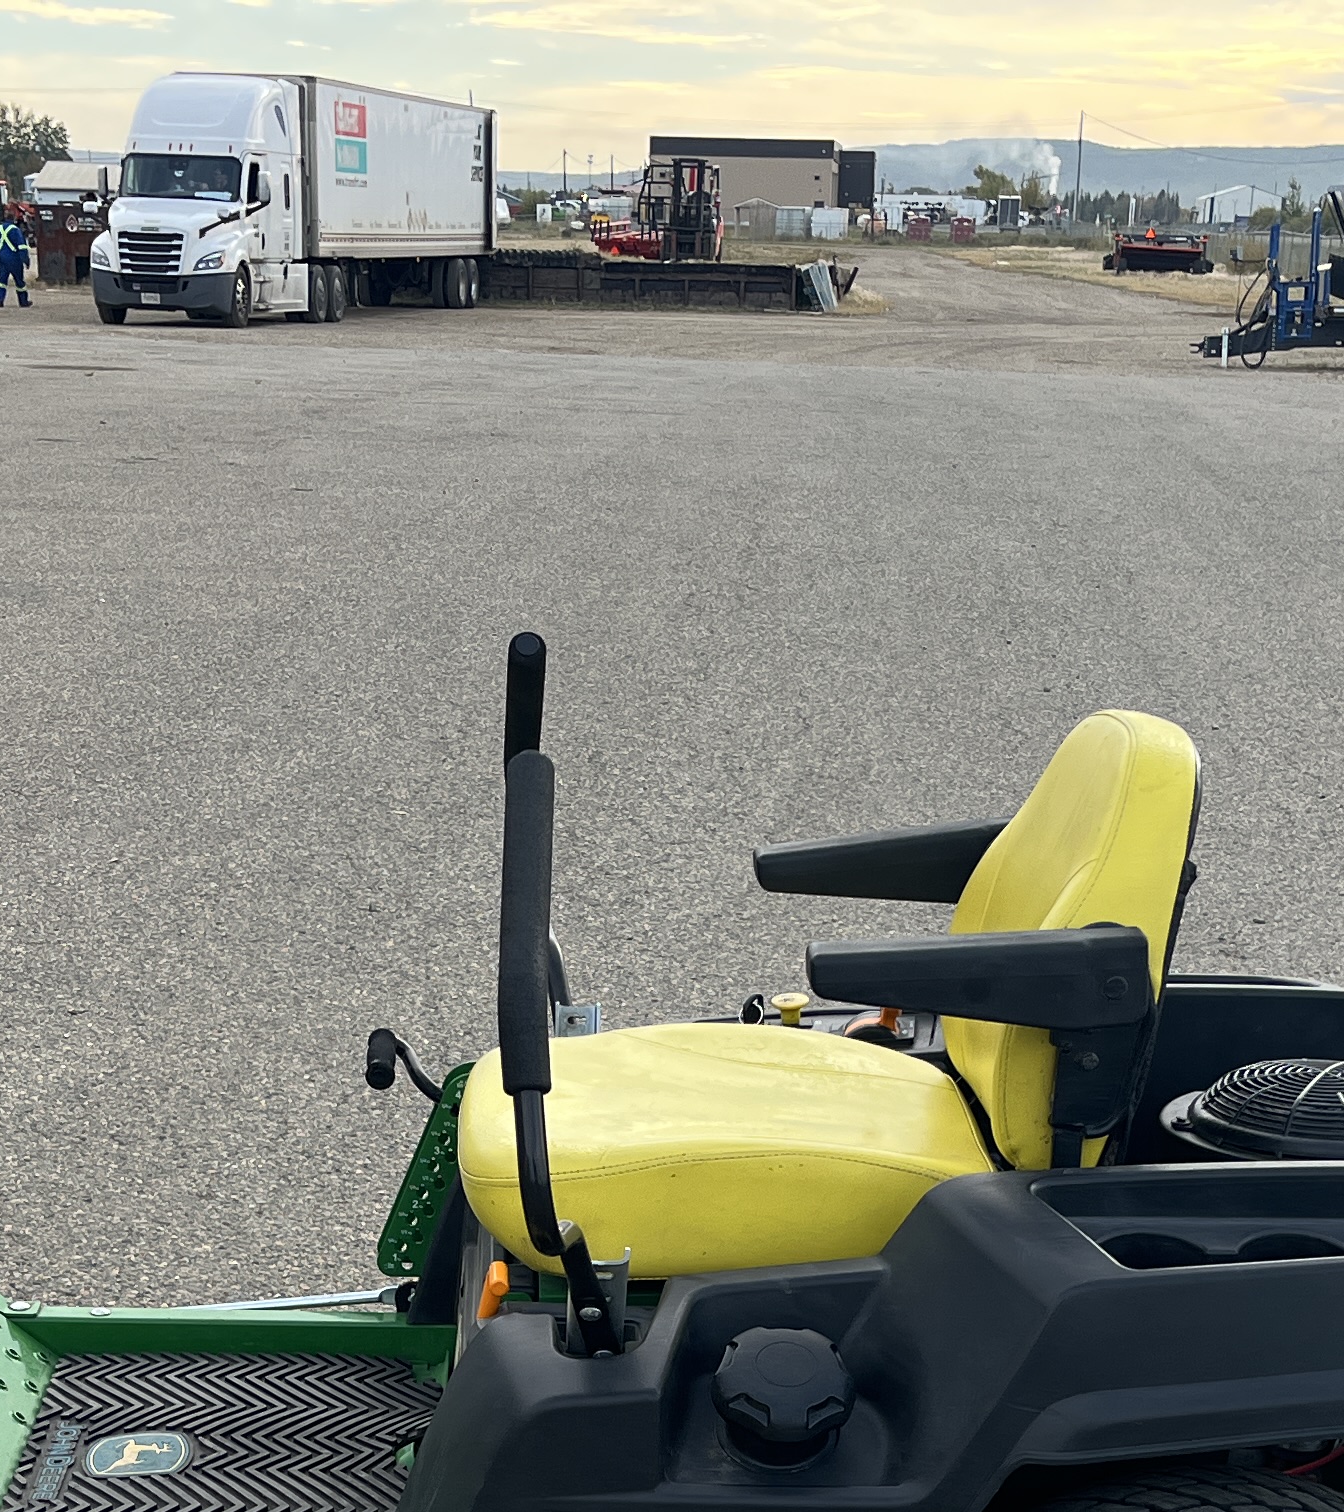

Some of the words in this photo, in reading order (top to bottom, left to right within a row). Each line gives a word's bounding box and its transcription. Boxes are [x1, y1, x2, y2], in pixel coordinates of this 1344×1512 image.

[434, 1146, 441, 1156] 3
[412, 1200, 419, 1209] 2
[392, 1253, 398, 1262] 1
[50, 1421, 87, 1456] JOHN
[32, 1454, 76, 1500] DEERE
